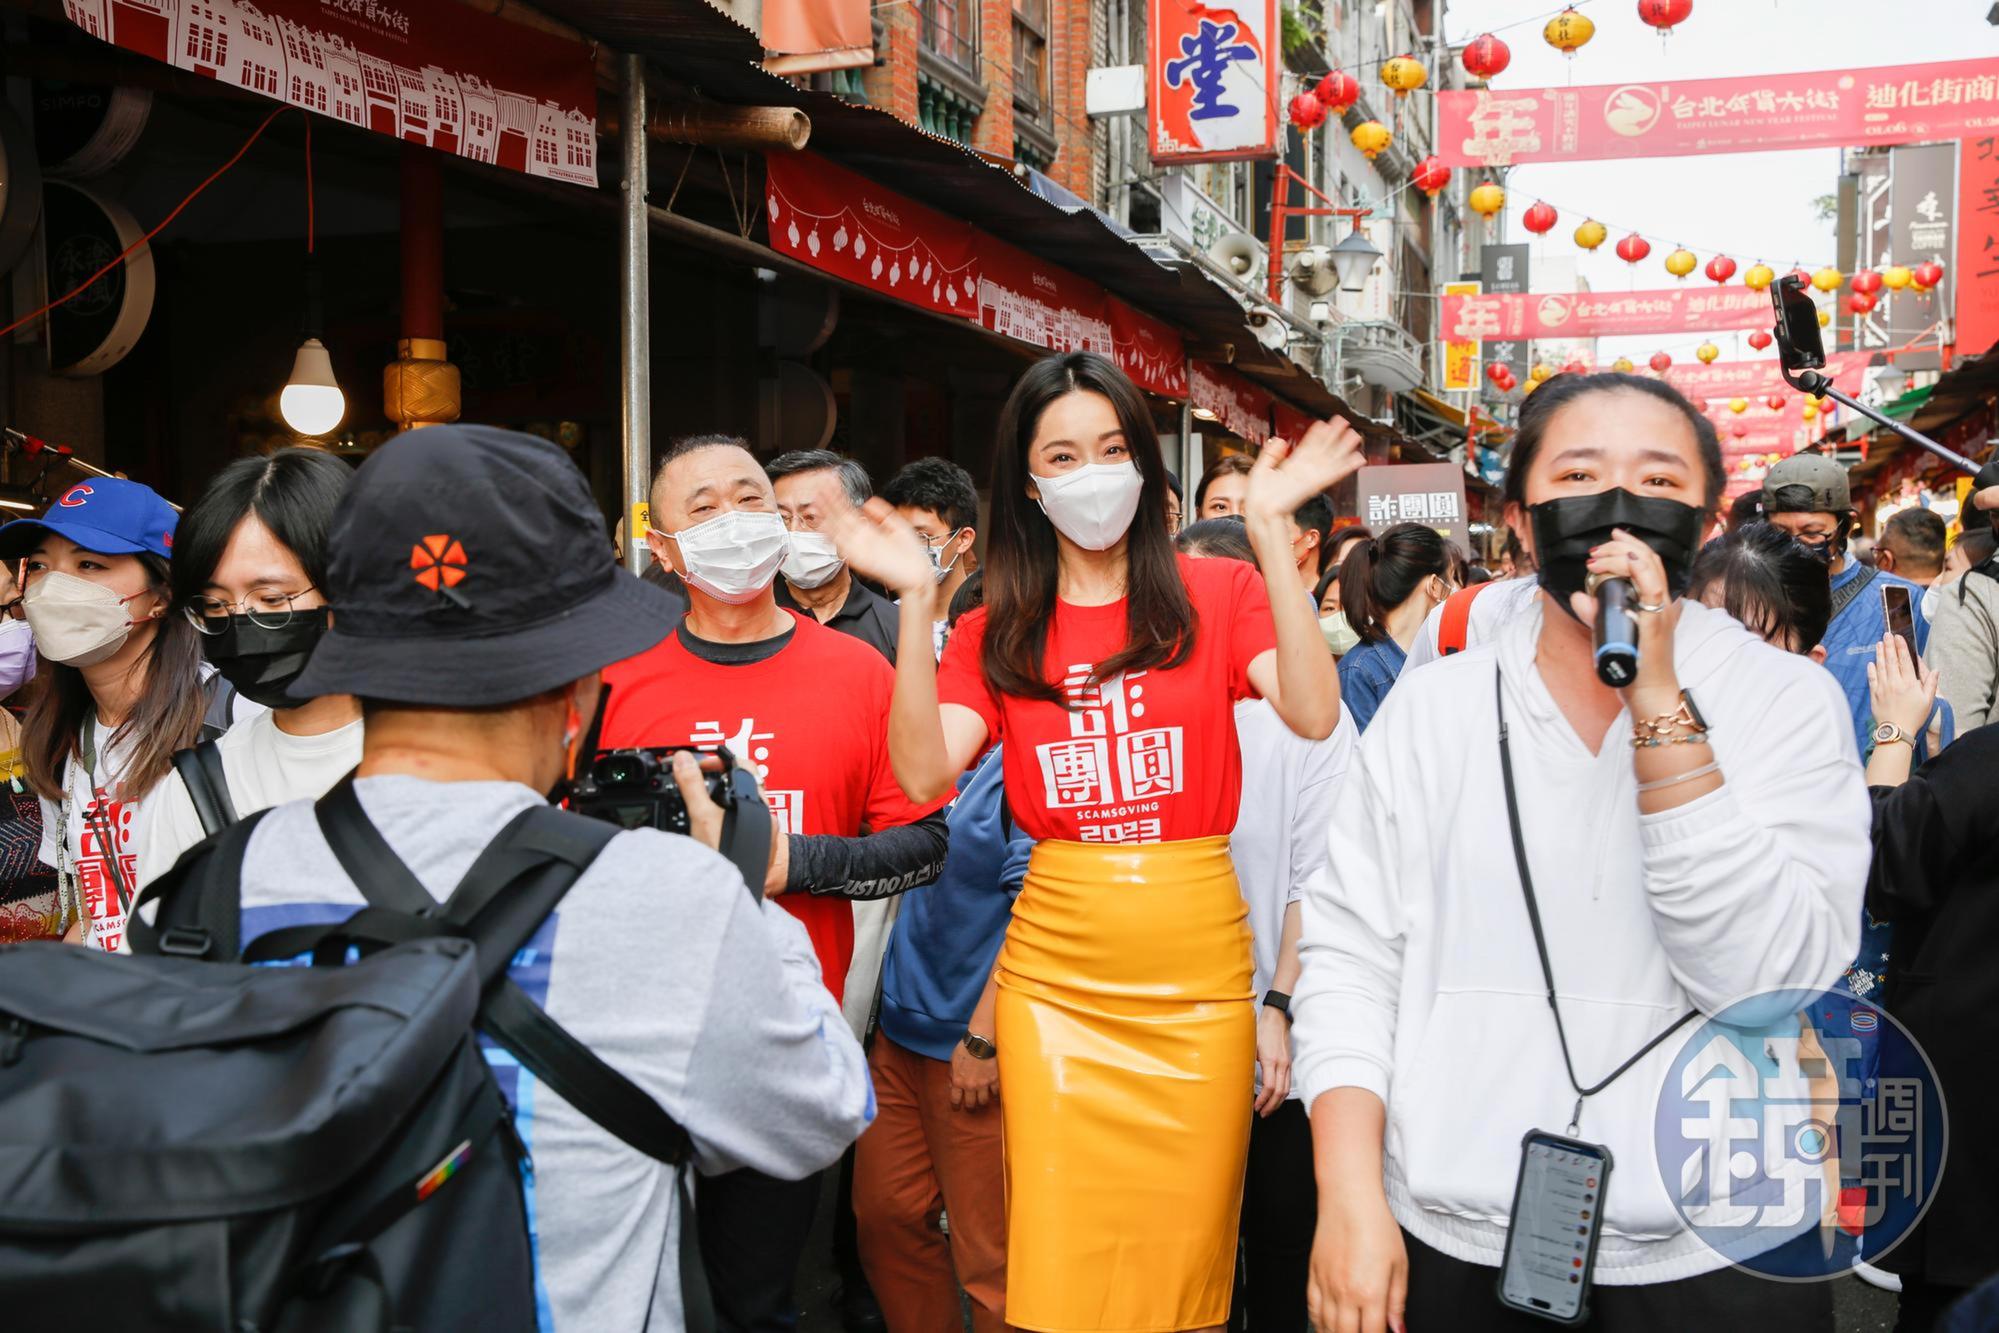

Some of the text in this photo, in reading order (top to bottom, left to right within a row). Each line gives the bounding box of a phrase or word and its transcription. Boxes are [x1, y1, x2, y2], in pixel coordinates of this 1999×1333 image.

[1166, 20, 1257, 121] 堂
[1671, 88, 1840, 119] 台北年貨大街
[1865, 75, 1999, 108] 迪化街商
[1462, 90, 1541, 166] 年
[60, 484, 94, 507] C
[1036, 726, 1183, 808] 團圓
[1077, 801, 1159, 820] SCAMSGVING
[1080, 818, 1161, 844] 2023
[876, 876, 900, 895] DO
